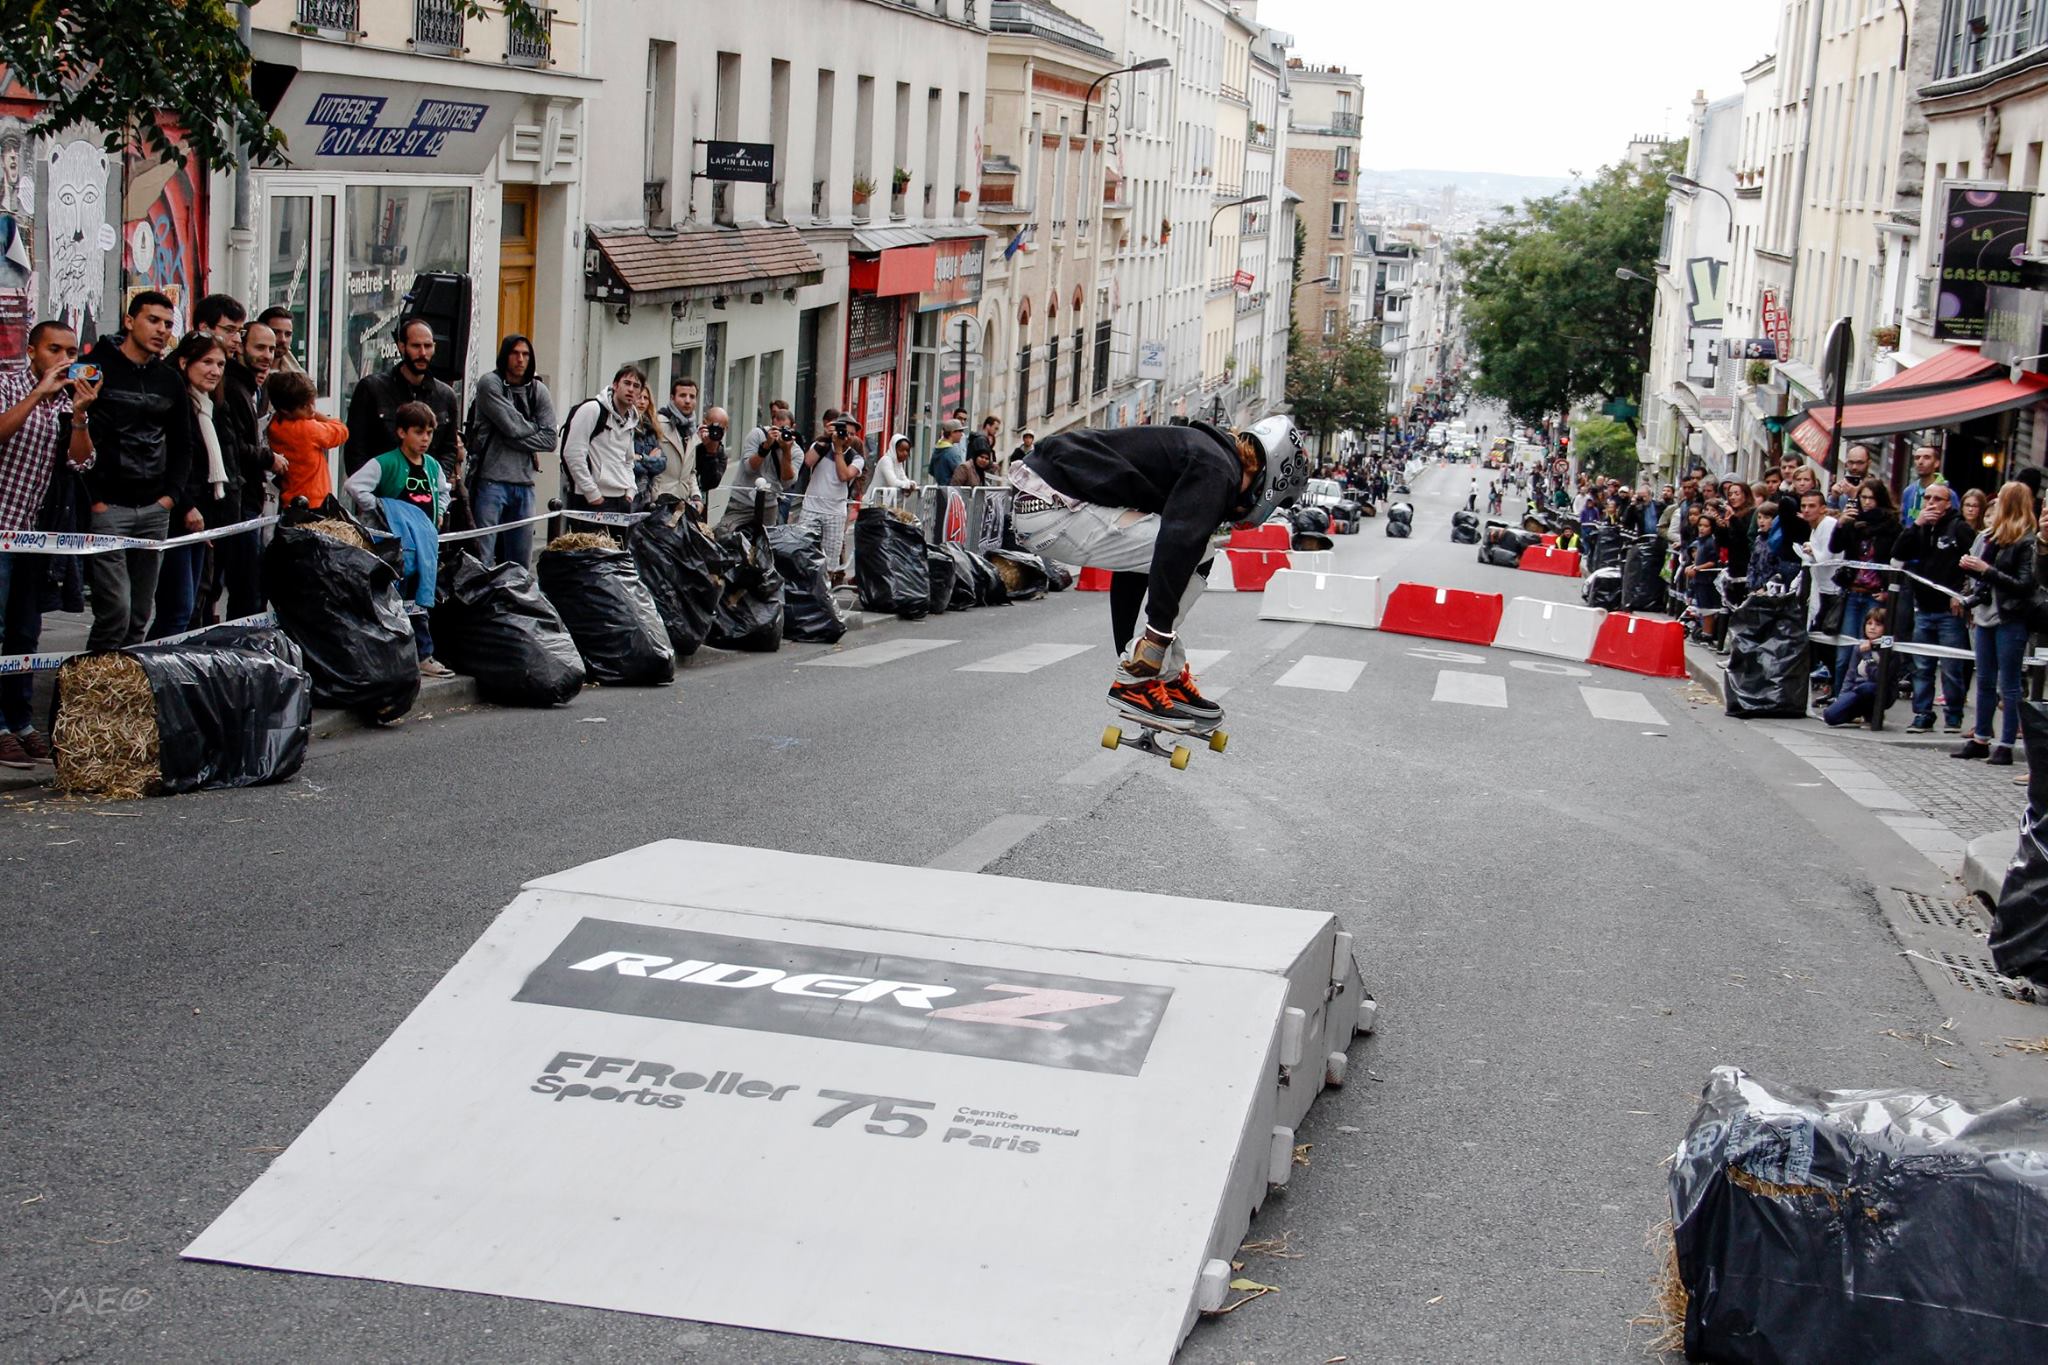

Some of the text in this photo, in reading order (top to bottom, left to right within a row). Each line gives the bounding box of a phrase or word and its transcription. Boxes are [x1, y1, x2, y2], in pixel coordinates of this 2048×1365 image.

[313, 96, 377, 125] VITRERIE
[417, 102, 483, 130] MIROITERIE
[333, 128, 450, 155] 01 44 62 97 42
[710, 157, 770, 168] LAPIN BLANC
[1971, 228, 1994, 241] LA
[346, 270, 383, 295] Fenêtres
[391, 268, 418, 294] Façad
[1942, 267, 2022, 284] CASCADE
[1148, 351, 1159, 360] 2
[13, 533, 47, 549] Crédit
[56, 534, 85, 549] Mutuel
[0, 656, 64, 672] rédit Mutuel
[530, 1075, 687, 1109] Sports
[812, 1088, 937, 1139] 75
[957, 1106, 1019, 1121] Comité
[942, 1127, 1042, 1155] Paris
